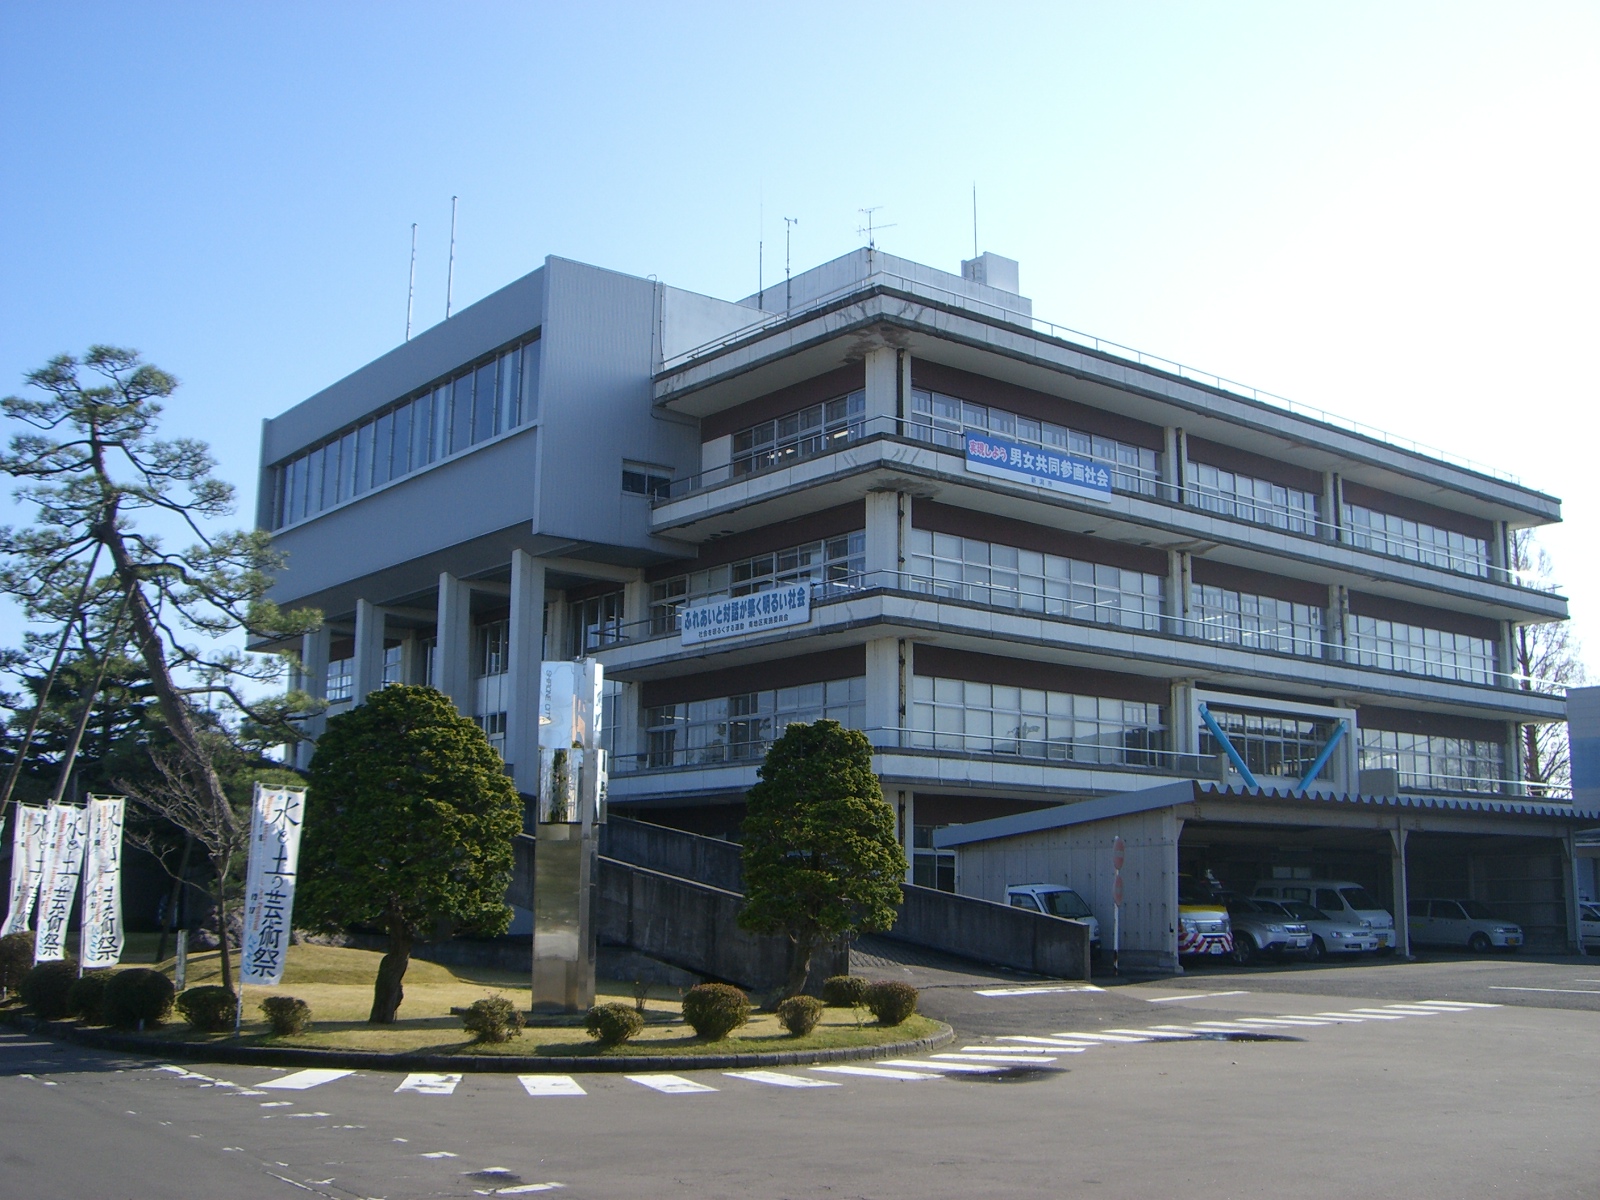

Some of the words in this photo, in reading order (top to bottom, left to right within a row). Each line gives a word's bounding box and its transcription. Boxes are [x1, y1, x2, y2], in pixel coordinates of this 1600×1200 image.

[968, 439, 1008, 462] 実現しよう
[1010, 447, 1109, 488] 男女共同参画社会
[684, 586, 806, 630] ふれあいと対話が築く明るい社会
[43, 816, 86, 957] 水と土の芸術祭
[97, 805, 121, 961] 水と土芸術祭
[251, 796, 301, 978] 水と土の芸術祭
